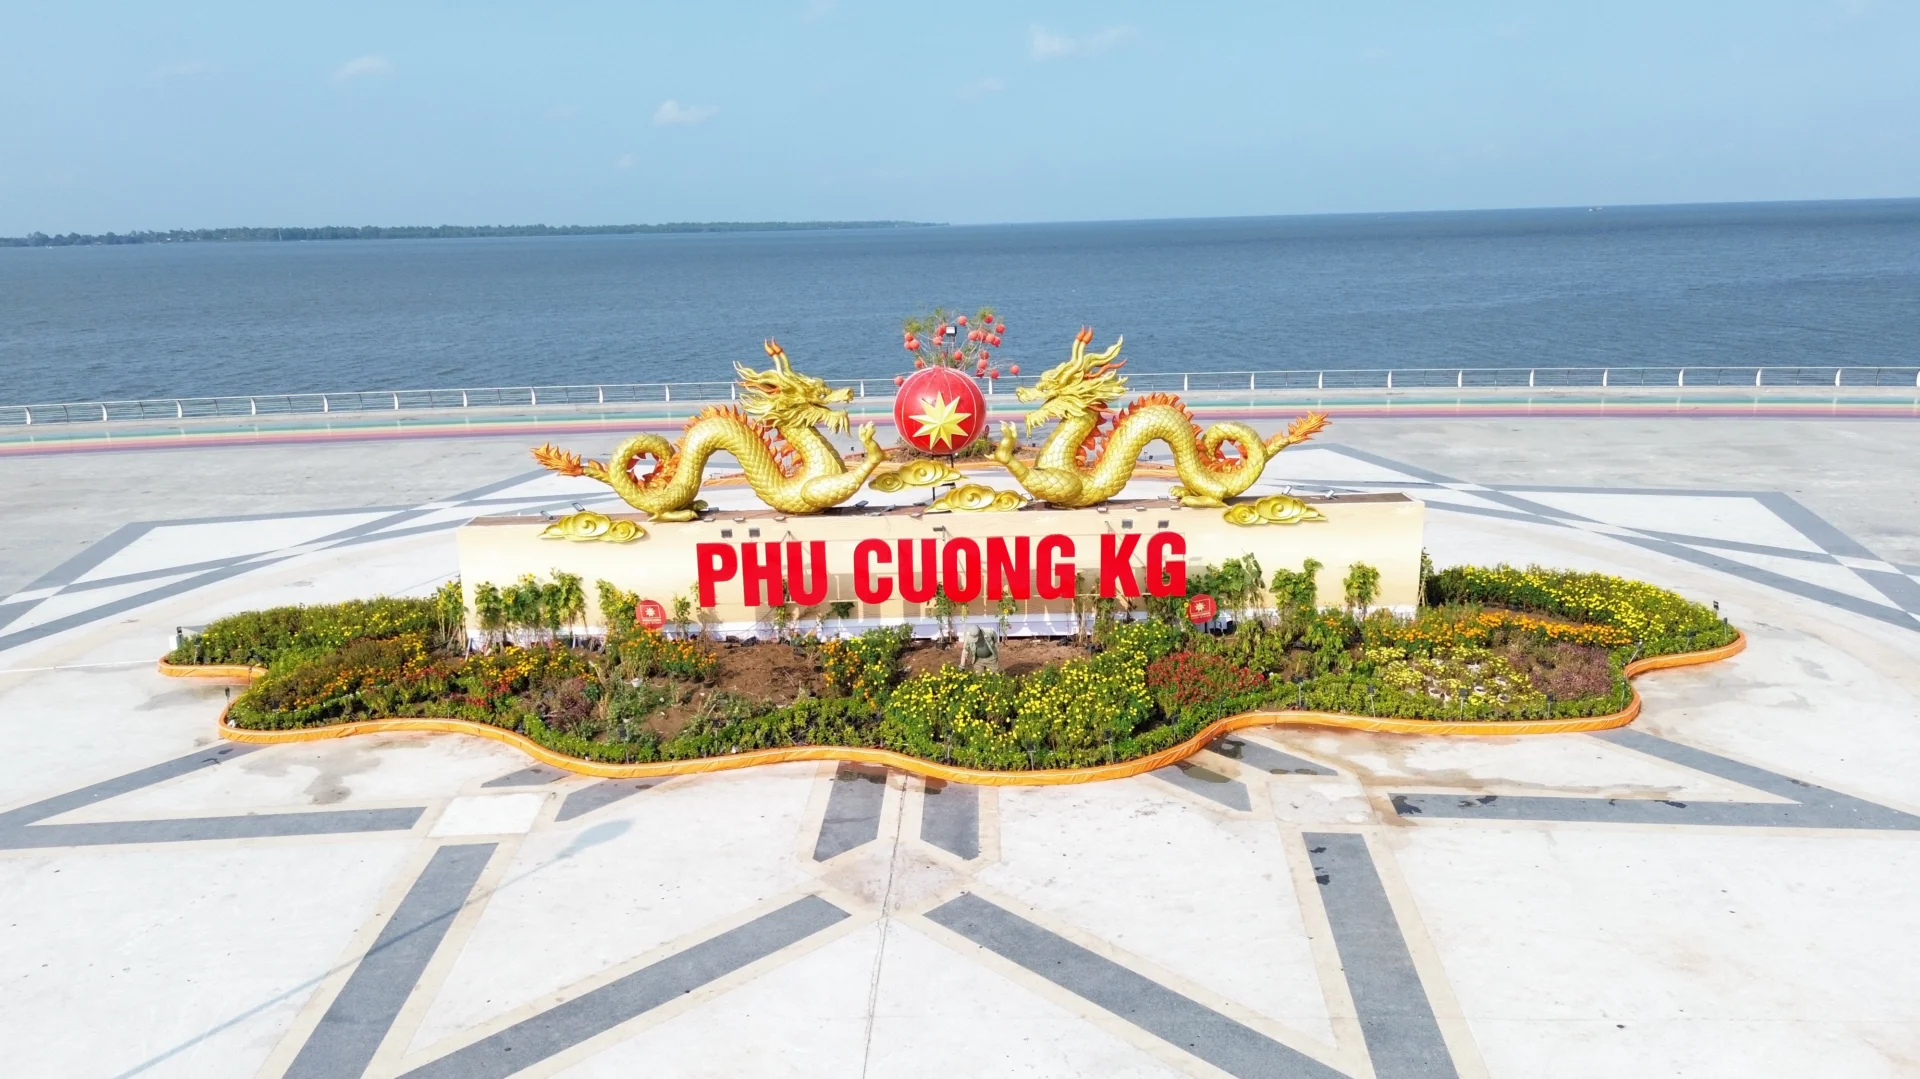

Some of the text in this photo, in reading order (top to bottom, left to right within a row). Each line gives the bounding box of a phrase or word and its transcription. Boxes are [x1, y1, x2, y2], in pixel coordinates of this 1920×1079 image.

[696, 531, 1187, 608] PHU CUONG KG
